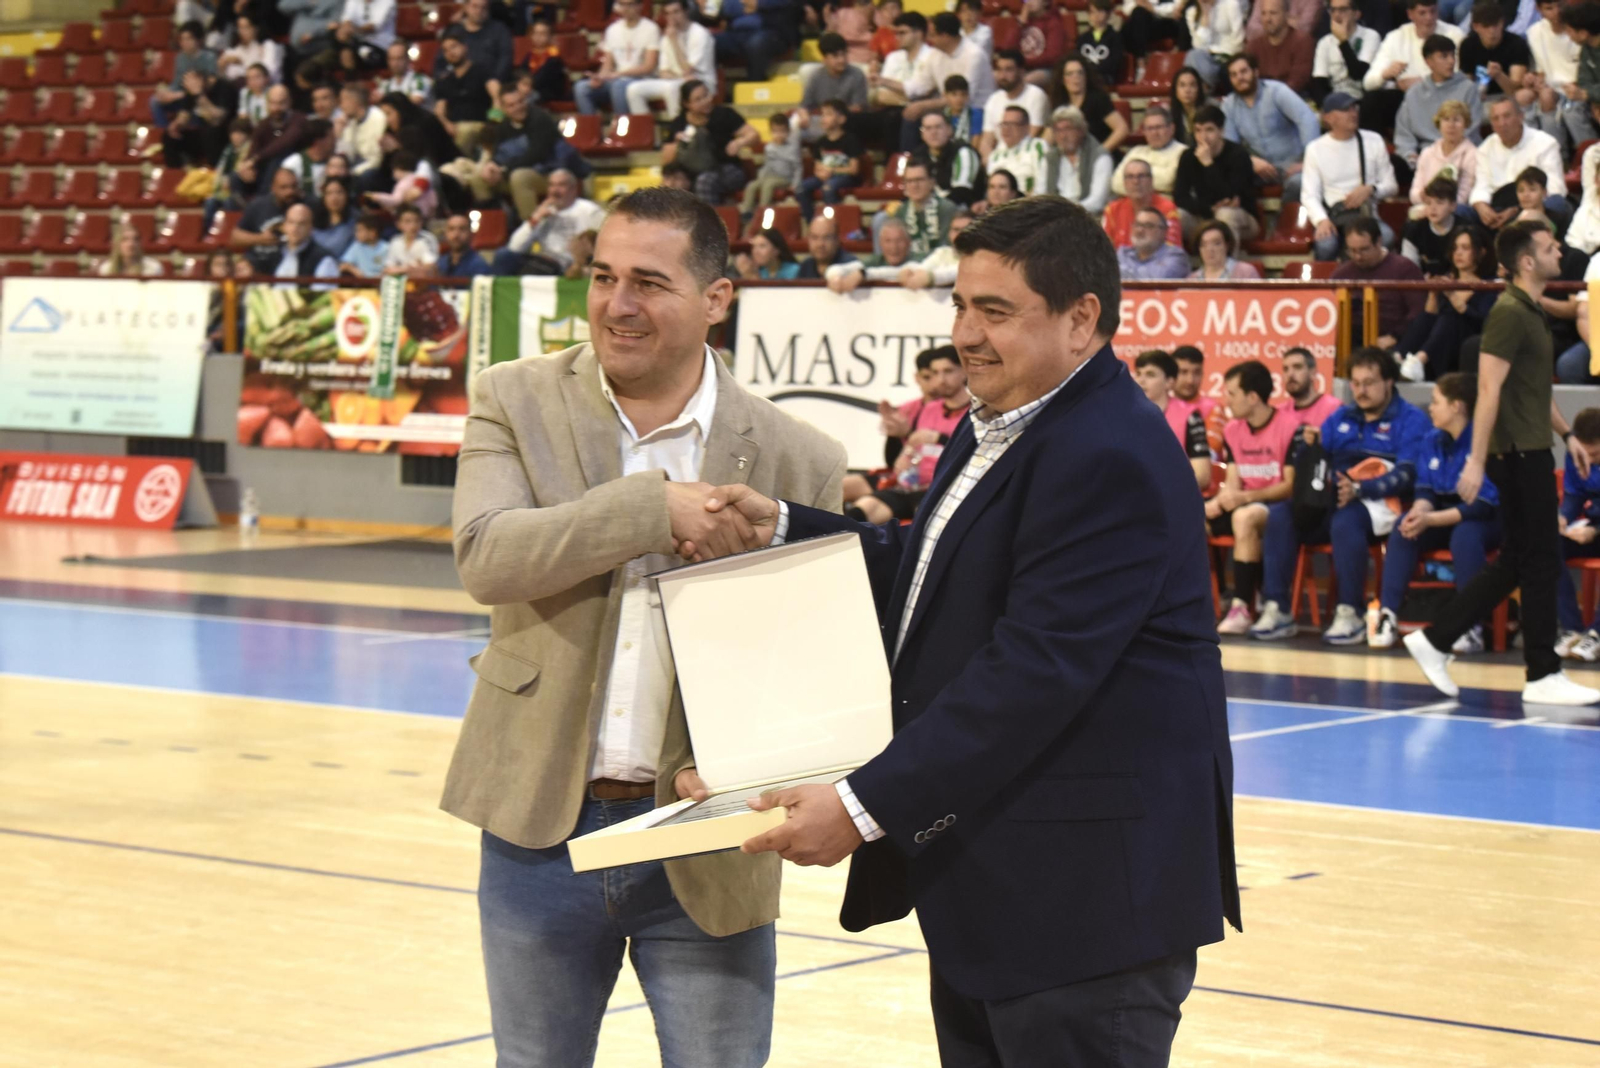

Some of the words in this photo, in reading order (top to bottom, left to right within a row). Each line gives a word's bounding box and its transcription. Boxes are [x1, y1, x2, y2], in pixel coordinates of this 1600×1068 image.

[62, 310, 196, 328] PLATECOR
[1202, 297, 1338, 337] MAGO
[1214, 341, 1260, 358] 14004
[18, 460, 128, 483] DIVISIÓN
[70, 481, 123, 520] SALA
